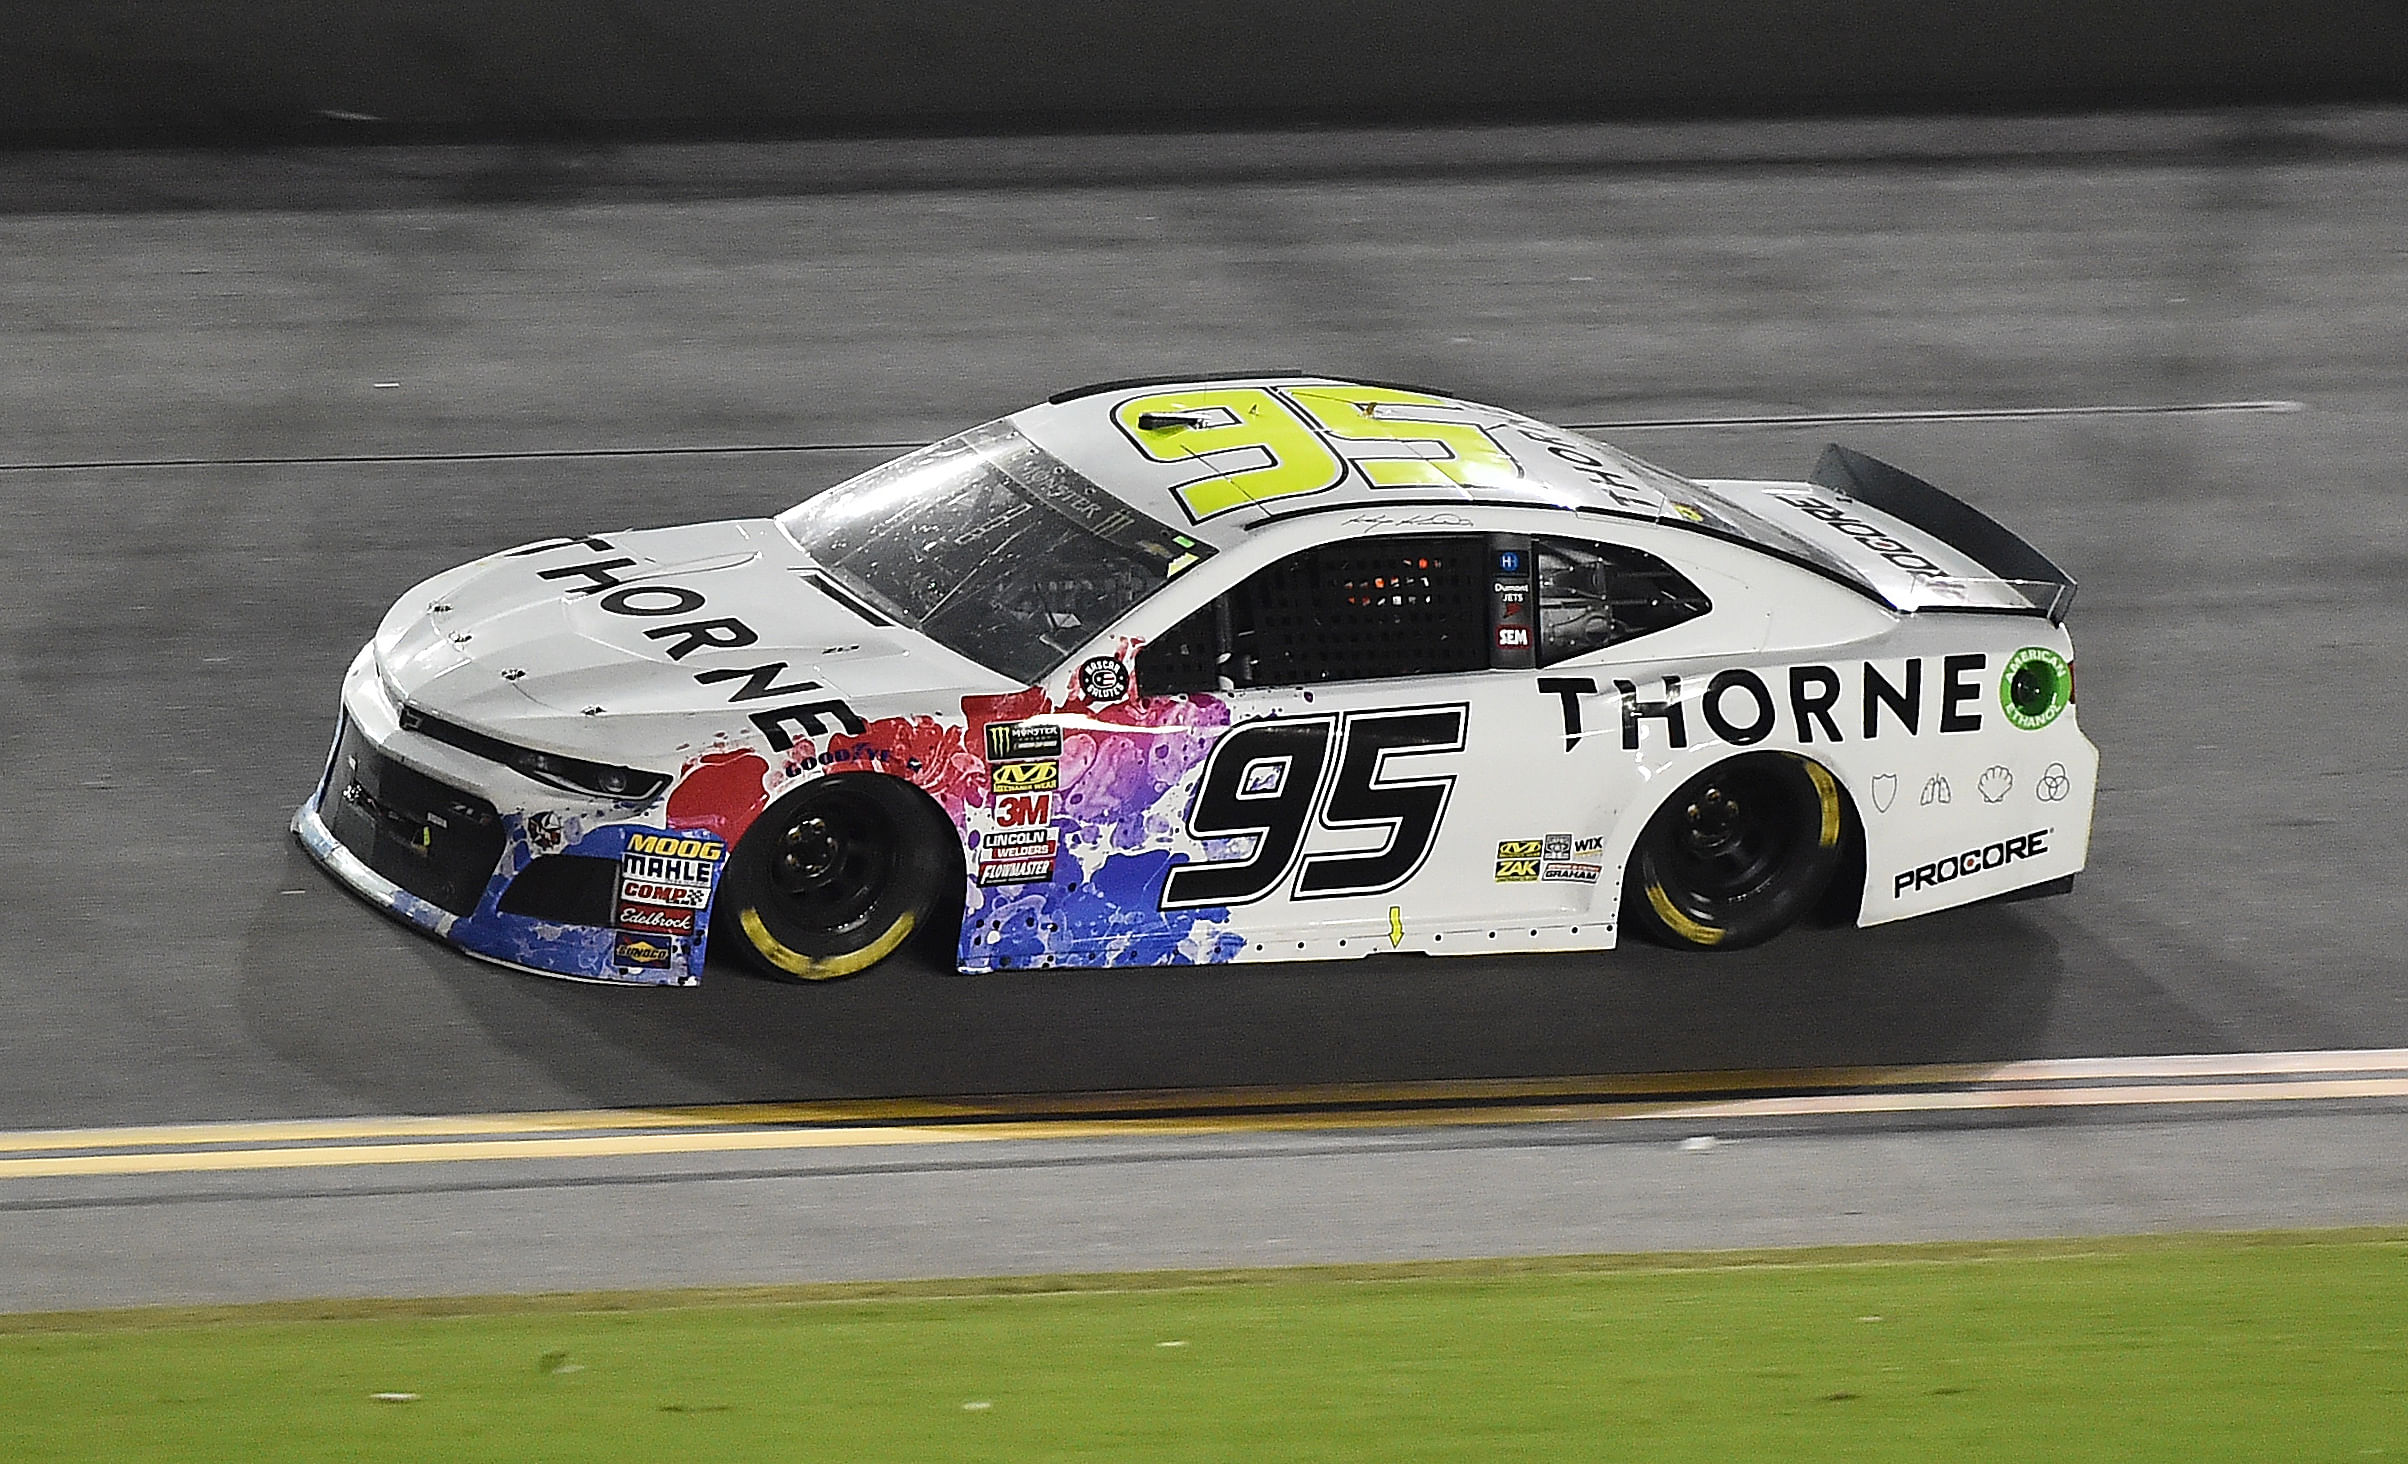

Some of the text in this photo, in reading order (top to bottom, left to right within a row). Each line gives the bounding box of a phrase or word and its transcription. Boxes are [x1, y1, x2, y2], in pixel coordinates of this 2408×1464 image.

[1110, 385, 1524, 526] 95
[1503, 593, 1524, 602] JETS
[504, 538, 866, 752] THORNE
[1499, 629, 1528, 645] SEM
[1085, 660, 1121, 675] NASCAR
[2006, 650, 2067, 683] AMERICAN
[1086, 684, 1125, 699] SALUTES
[1537, 654, 1986, 752] THORNE
[2006, 692, 2058, 727] ETHANOL
[1012, 727, 1058, 737] MONSTER
[997, 795, 1049, 827] 3M
[1159, 701, 1470, 911] 95
[628, 834, 725, 860] MOOG
[986, 832, 1045, 848] LINCOLN
[1575, 836, 1603, 852] WIX
[996, 845, 1049, 859] WELDERS
[624, 857, 710, 882] MAHLE
[981, 861, 1050, 884] FLOWMASTER
[1497, 861, 1539, 876] ZAK
[1895, 829, 2049, 899] PROCORE
[1546, 870, 1598, 880] GRAHAM
[625, 882, 687, 902] COMP
[620, 908, 691, 930] Edelbrock
[616, 945, 669, 961] SUNOCO
